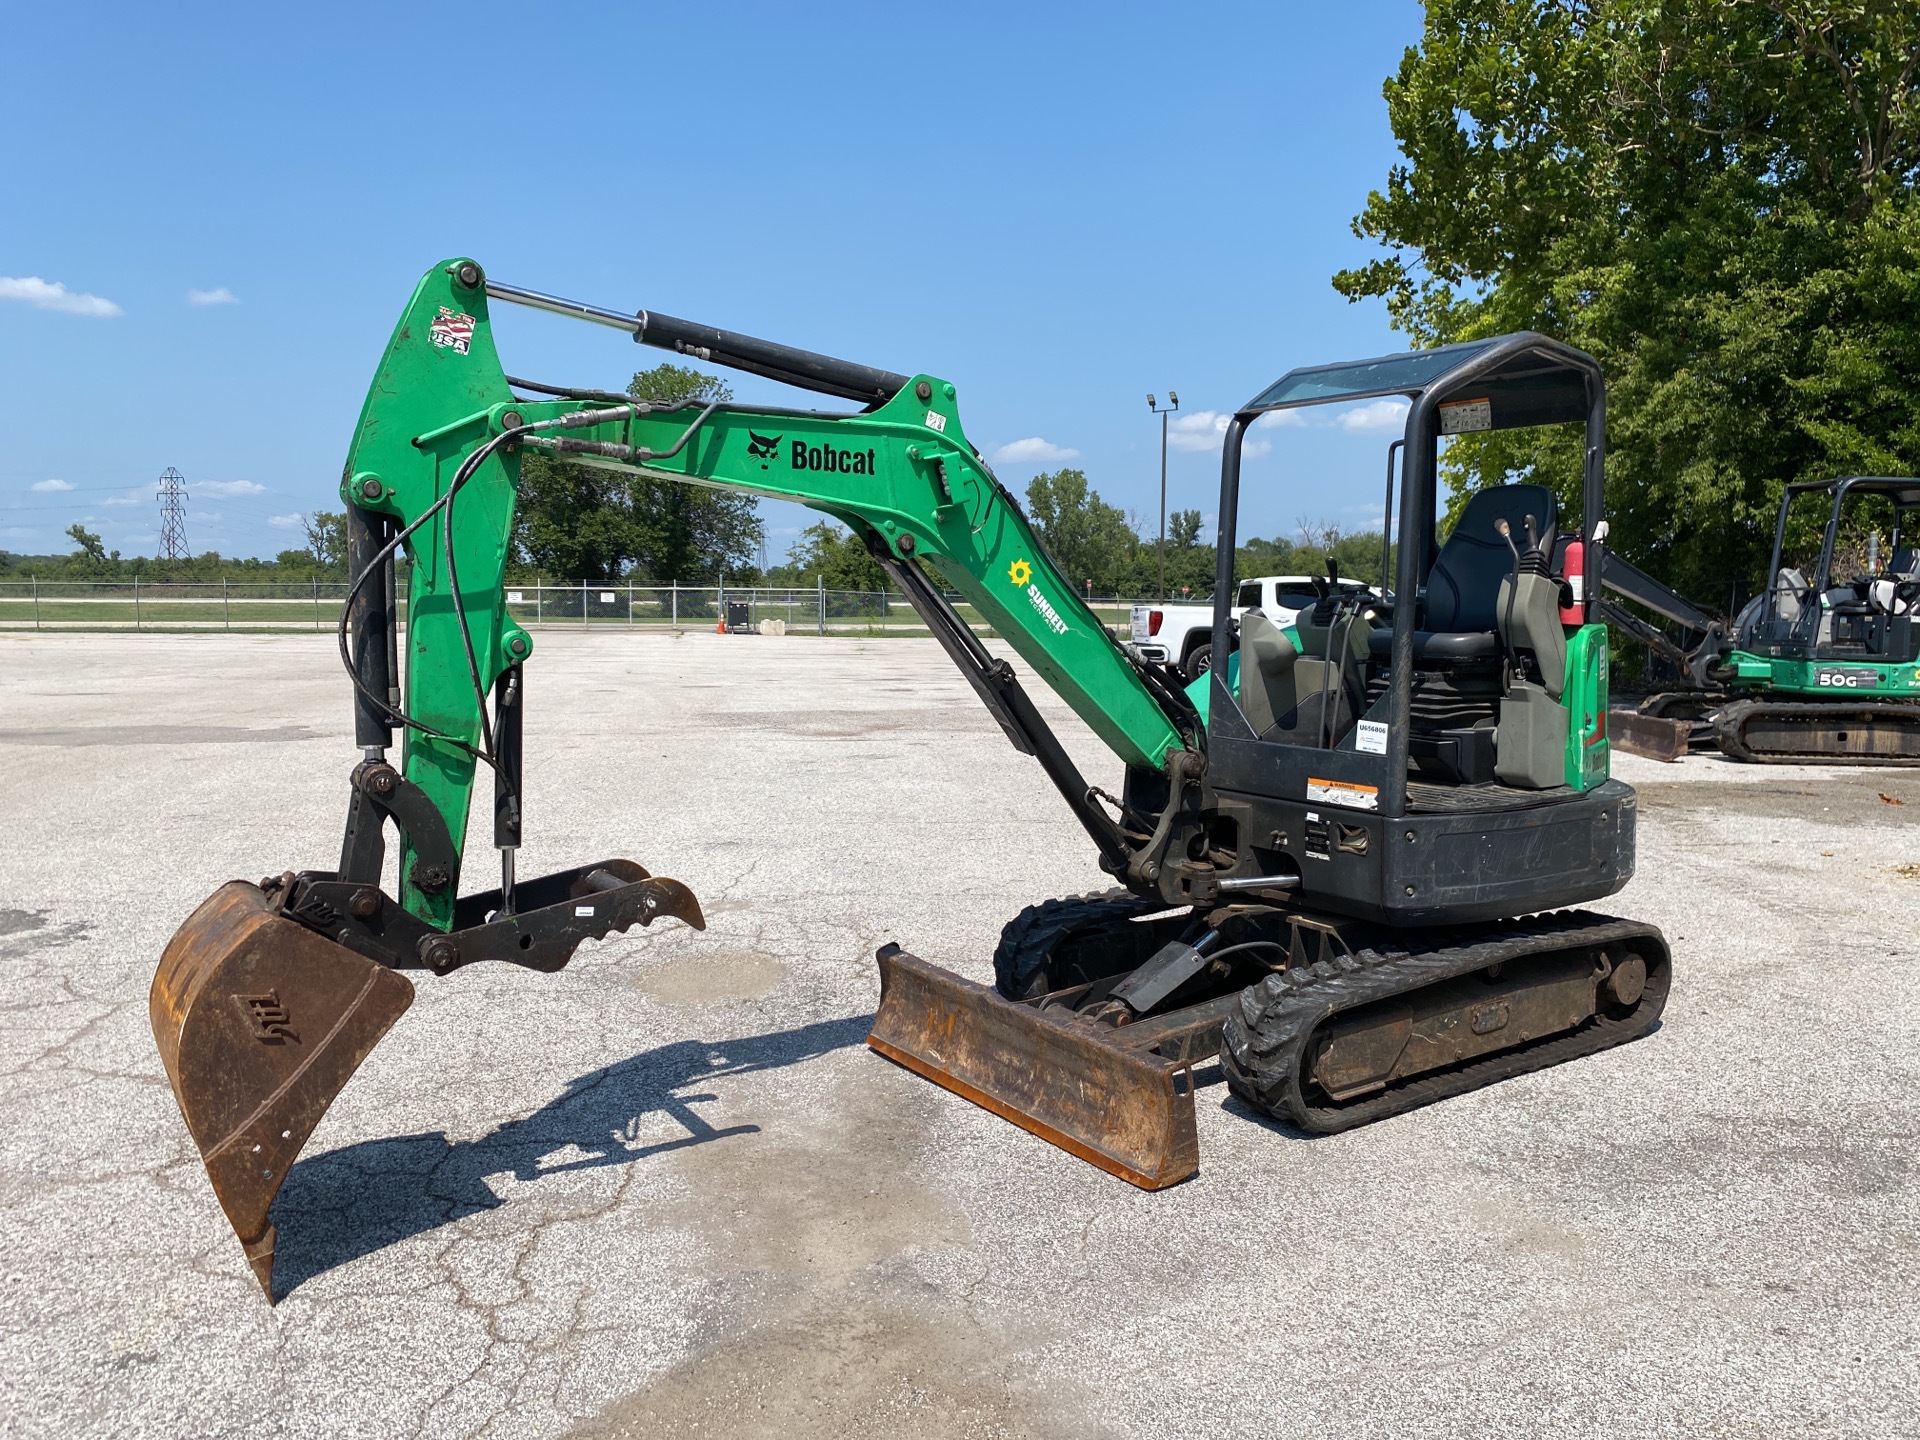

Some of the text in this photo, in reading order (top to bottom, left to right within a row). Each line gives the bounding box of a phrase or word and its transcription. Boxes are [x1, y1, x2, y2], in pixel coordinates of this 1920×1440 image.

[791, 440, 875, 476] Bobcat
[1027, 583, 1069, 635] SUNBELT
[1820, 673, 1857, 688] 50G
